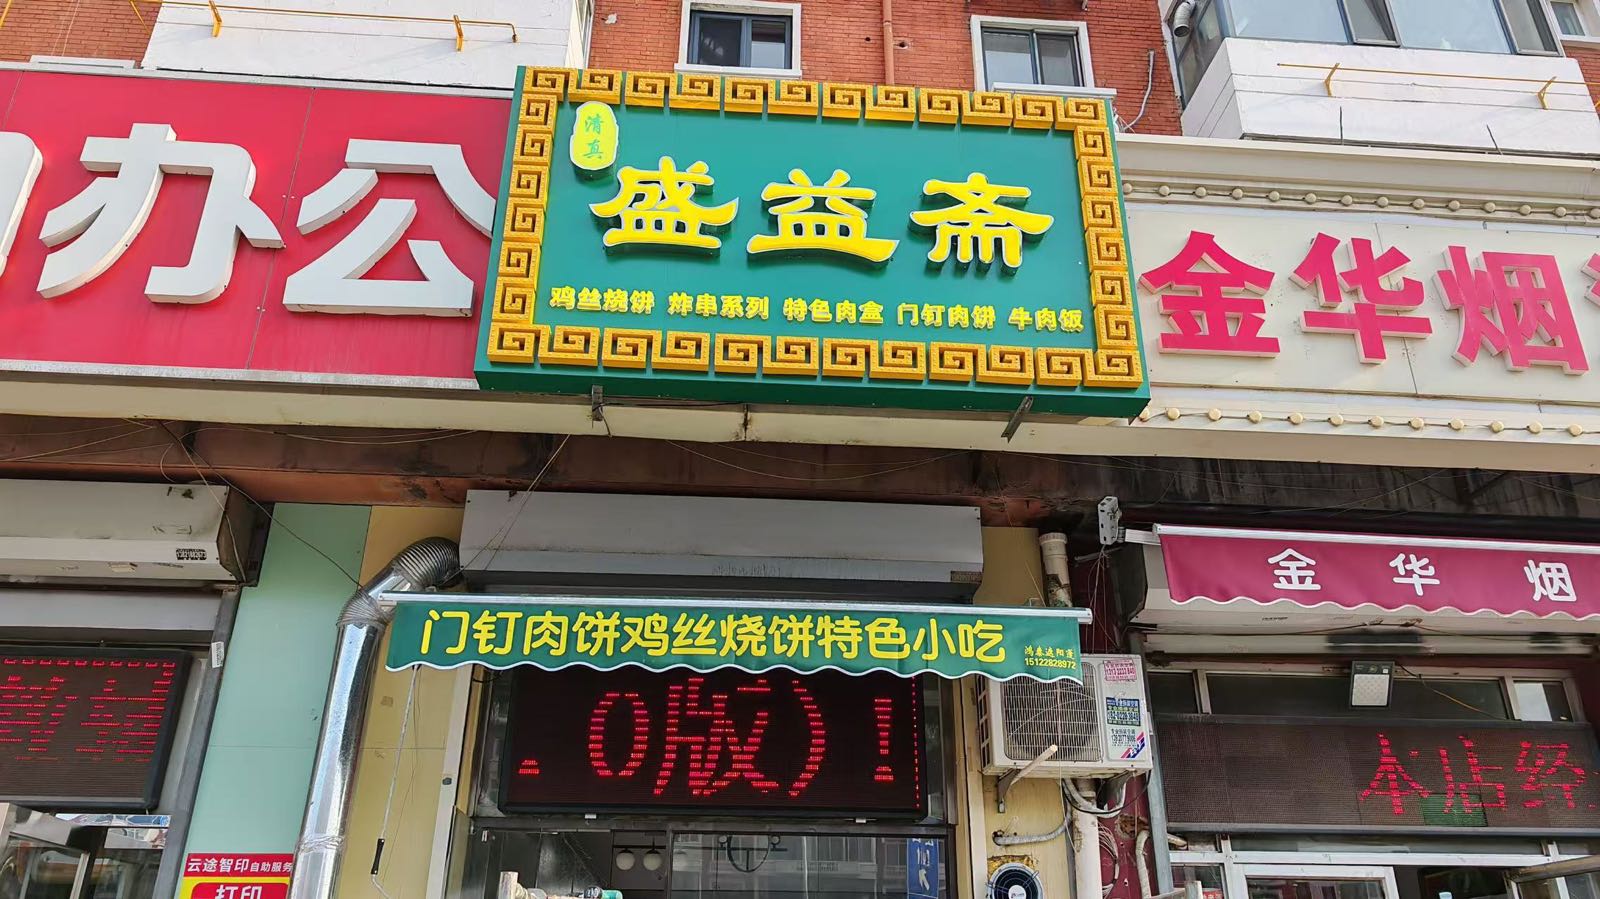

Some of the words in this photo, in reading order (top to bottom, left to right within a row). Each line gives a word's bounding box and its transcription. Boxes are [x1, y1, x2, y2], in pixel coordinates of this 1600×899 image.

[583, 112, 604, 159] 清真
[588, 155, 1055, 271] 盛益斋
[549, 285, 655, 315] 鸡丝烧饼
[667, 291, 770, 320] 炸串系列
[782, 297, 884, 325] 特色肉盒
[897, 303, 996, 329] 门钉肉饼
[1008, 306, 1084, 332] 牛肉饭
[1140, 230, 1600, 376] 金华烟
[1267, 548, 1577, 602] 金华烟
[421, 609, 1006, 664] 门钉肉饼鸡丝烧饼特色小吃
[1024, 657, 1077, 669] 15122828972
